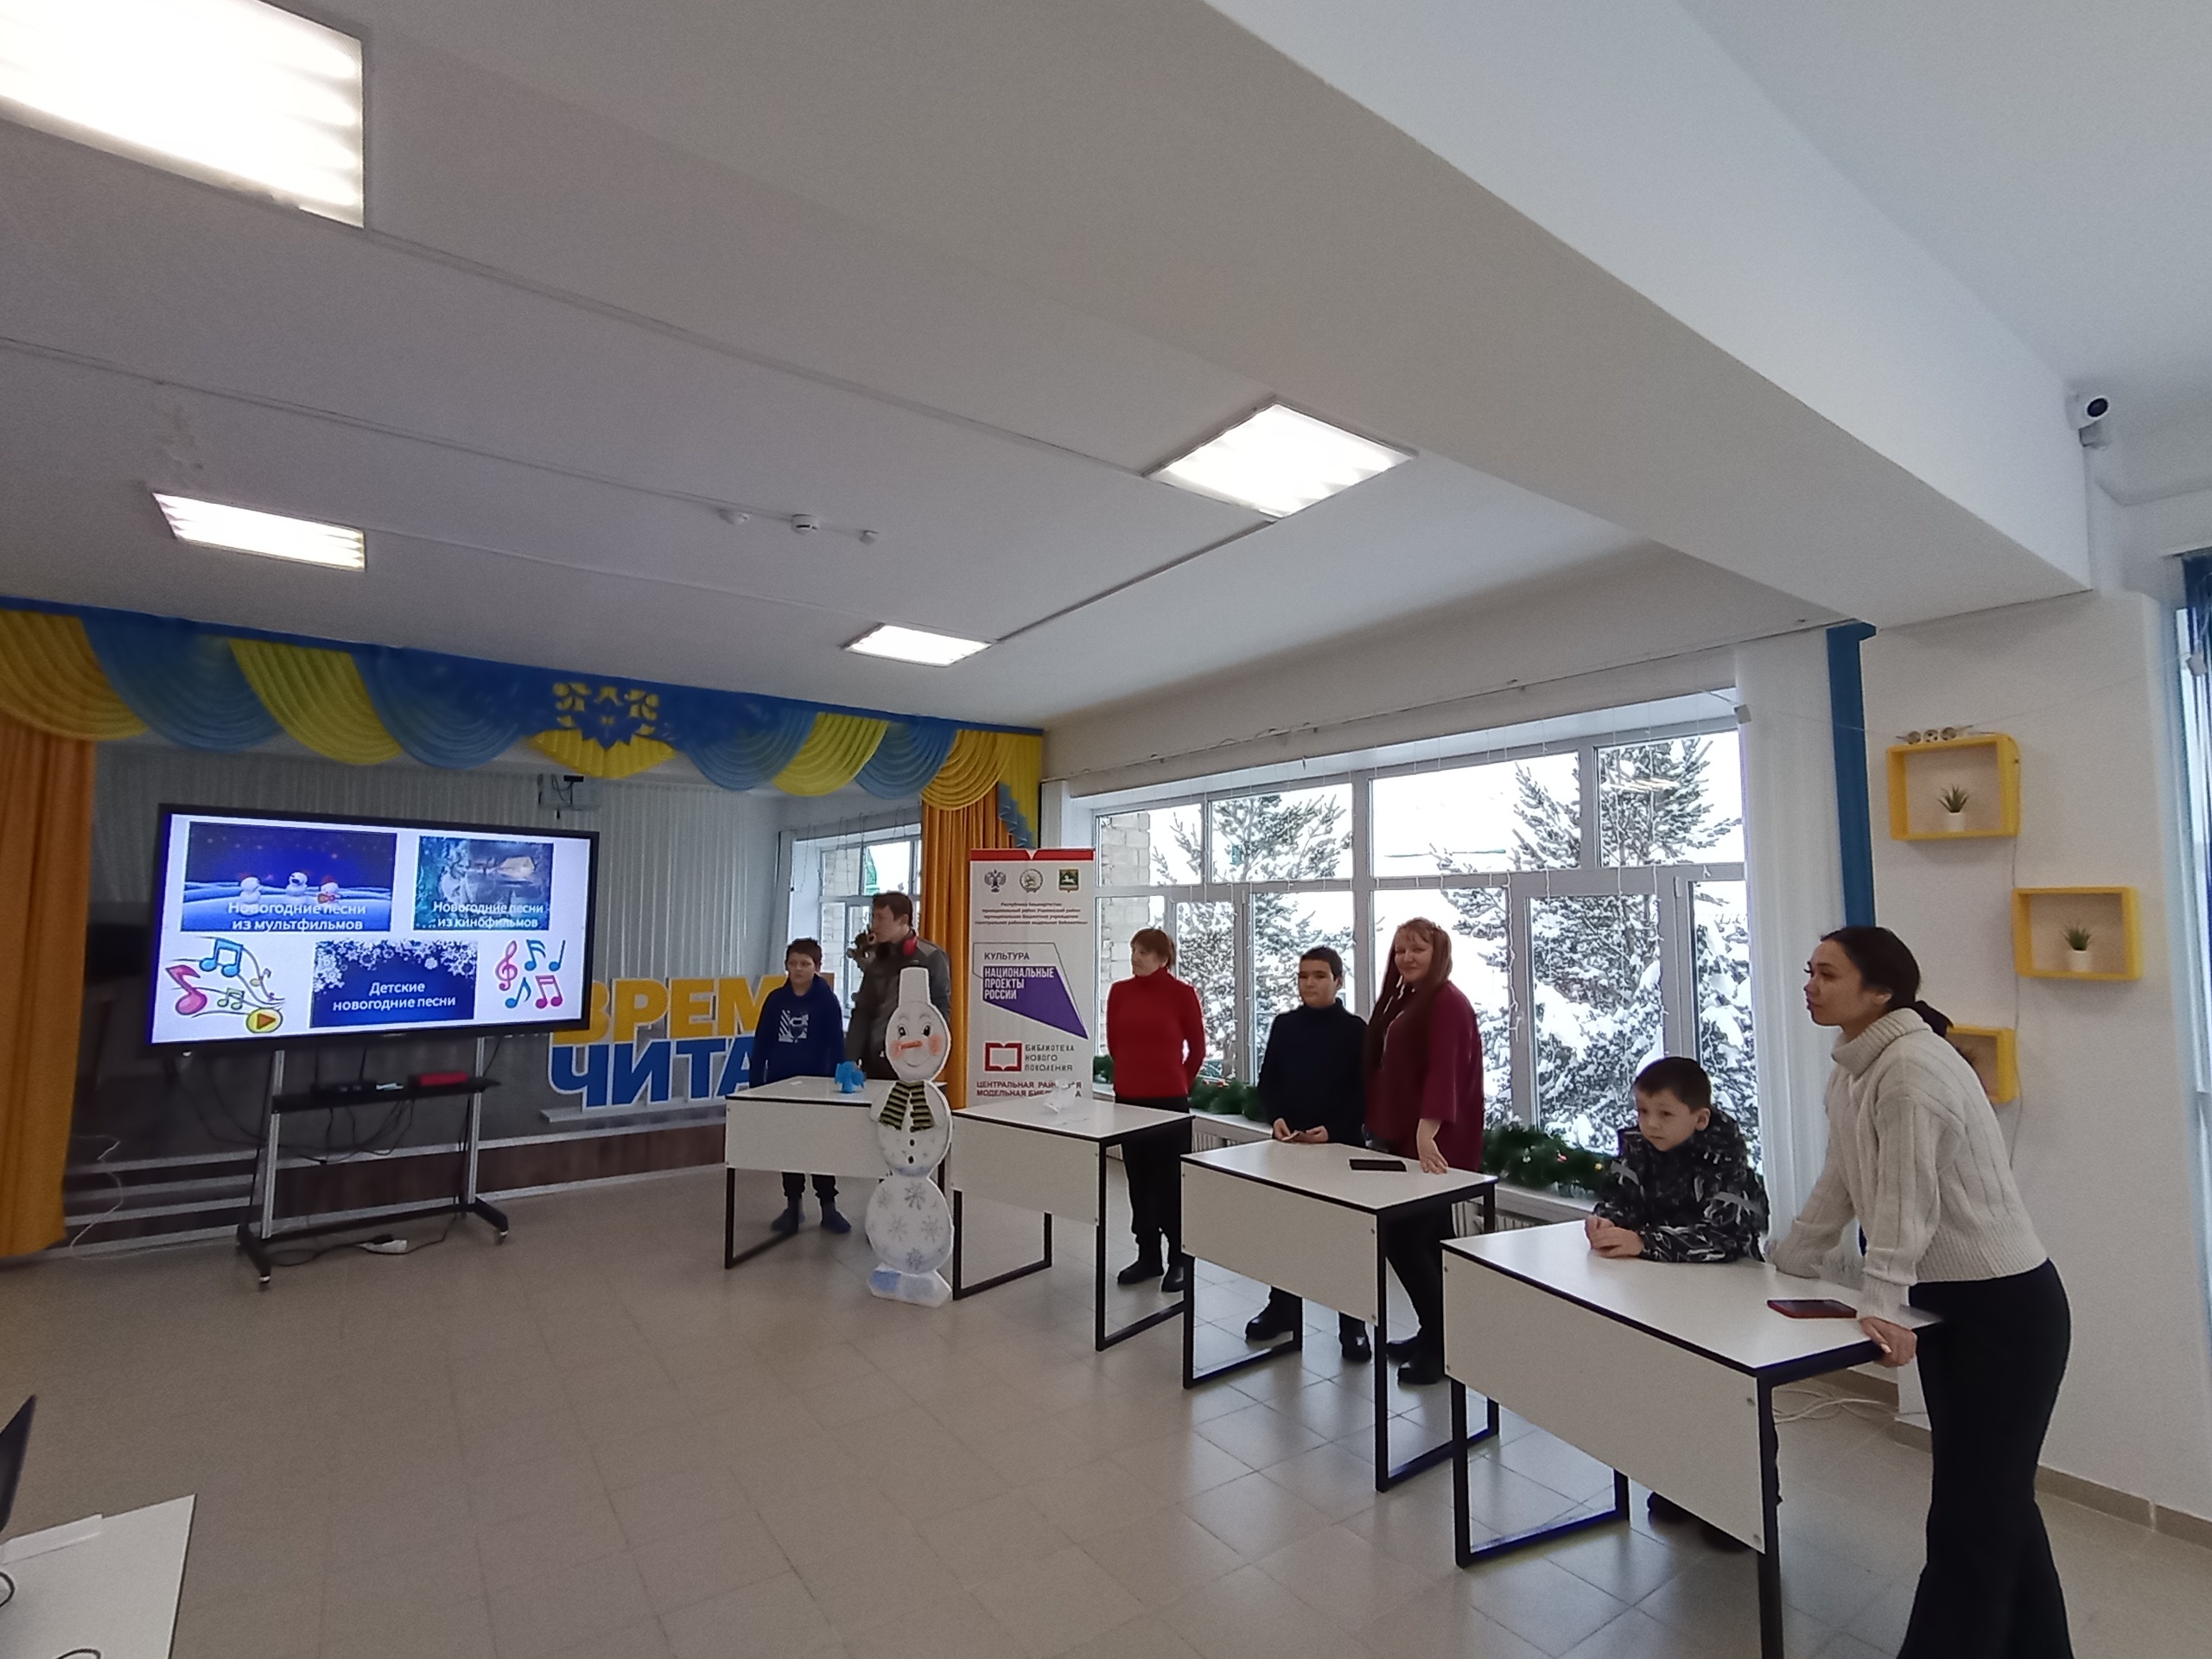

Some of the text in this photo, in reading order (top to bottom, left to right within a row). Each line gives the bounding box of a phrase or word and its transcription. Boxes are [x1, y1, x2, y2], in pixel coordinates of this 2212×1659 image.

[227, 901, 366, 916] Новогодние песни
[432, 901, 544, 915] Новогодние песни
[232, 918, 364, 932] из мультфильмов
[437, 916, 539, 930] из кинофильмов
[983, 951, 1030, 961] КУЛЬТУРА
[984, 967, 1055, 979] НАЦИОНАЛЬНЫЕ
[368, 982, 426, 997] Детские
[984, 978, 1025, 989] ПРОЕКТЫ
[984, 989, 1018, 1001] РОССИИ
[332, 996, 457, 1012] новогодние песни
[1025, 1044, 1075, 1052] БИБЛИОТЕКА
[1025, 1064, 1073, 1072] ПОКОЛЕНИЯ
[976, 1089, 1027, 1097] МОДЕЛЬНАЯ
